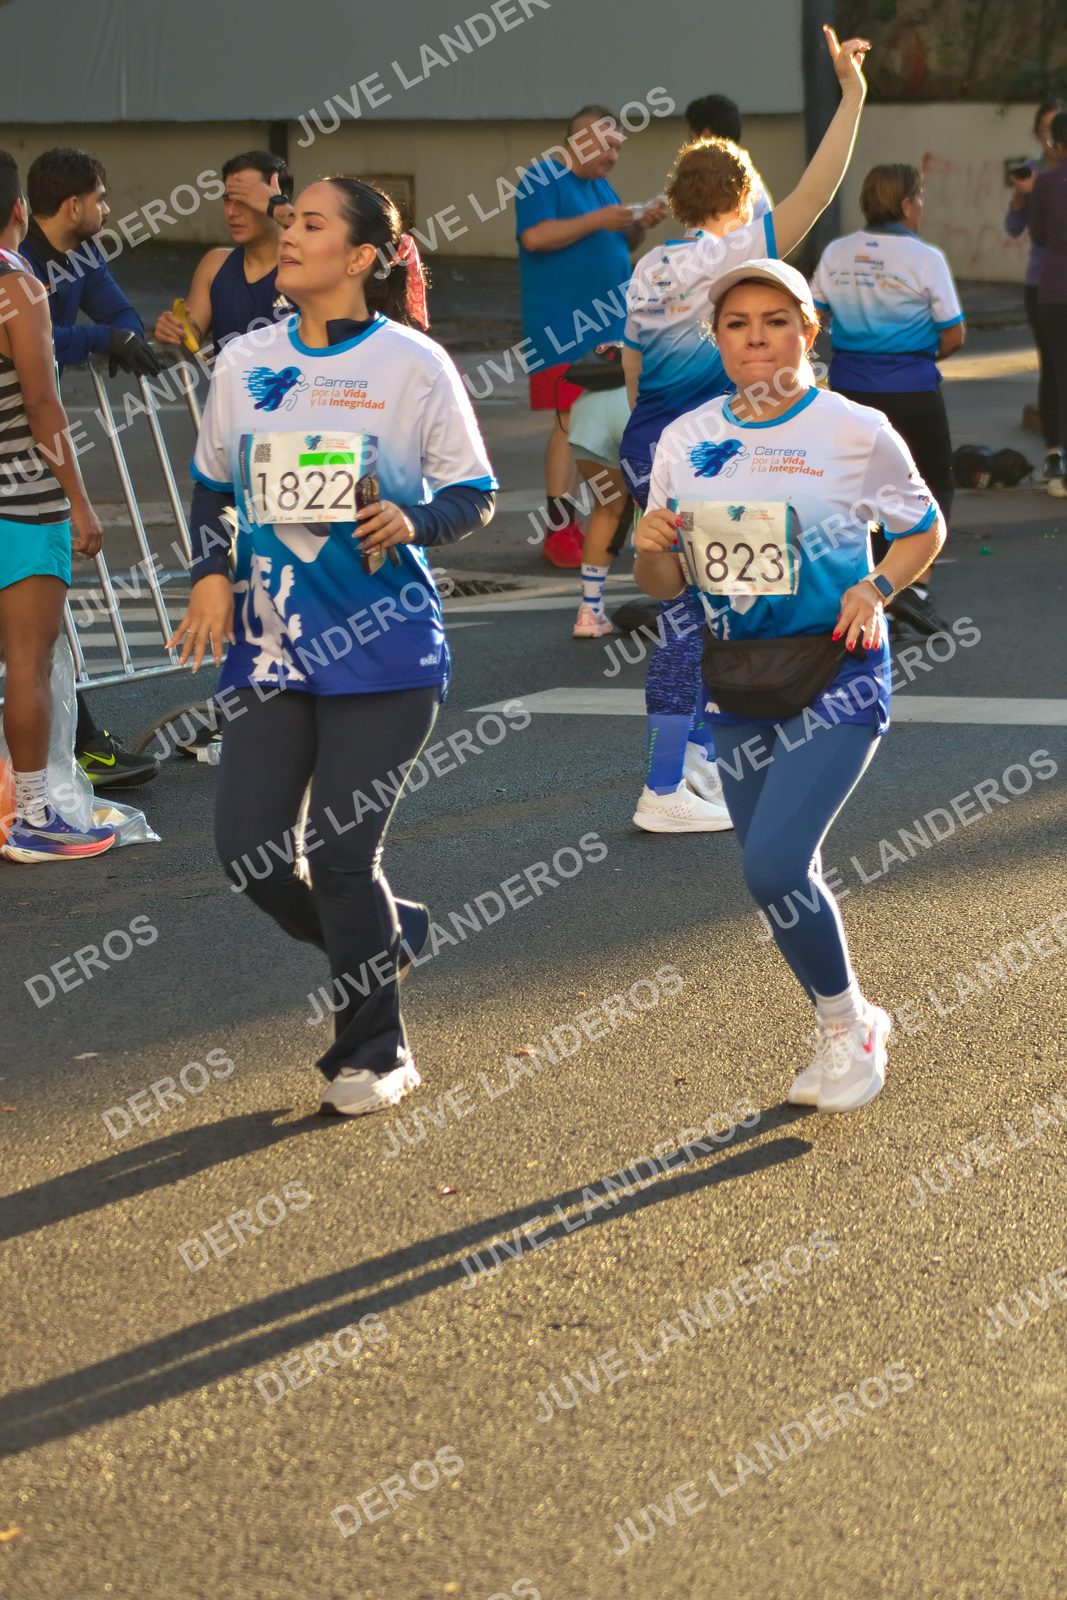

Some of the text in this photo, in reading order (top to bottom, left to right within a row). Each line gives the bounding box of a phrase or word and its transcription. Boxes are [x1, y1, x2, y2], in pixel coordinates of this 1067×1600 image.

[314, 376, 368, 388] Carrera
[311, 389, 367, 399] por la Vida
[318, 398, 326, 406] la
[328, 398, 385, 409] Integridad
[754, 446, 807, 457] Carrera
[752, 457, 805, 466] por la Vida
[758, 465, 767, 473] la
[769, 465, 824, 477] Integridad
[257, 470, 354, 511] 1822
[687, 541, 784, 583] 1823
